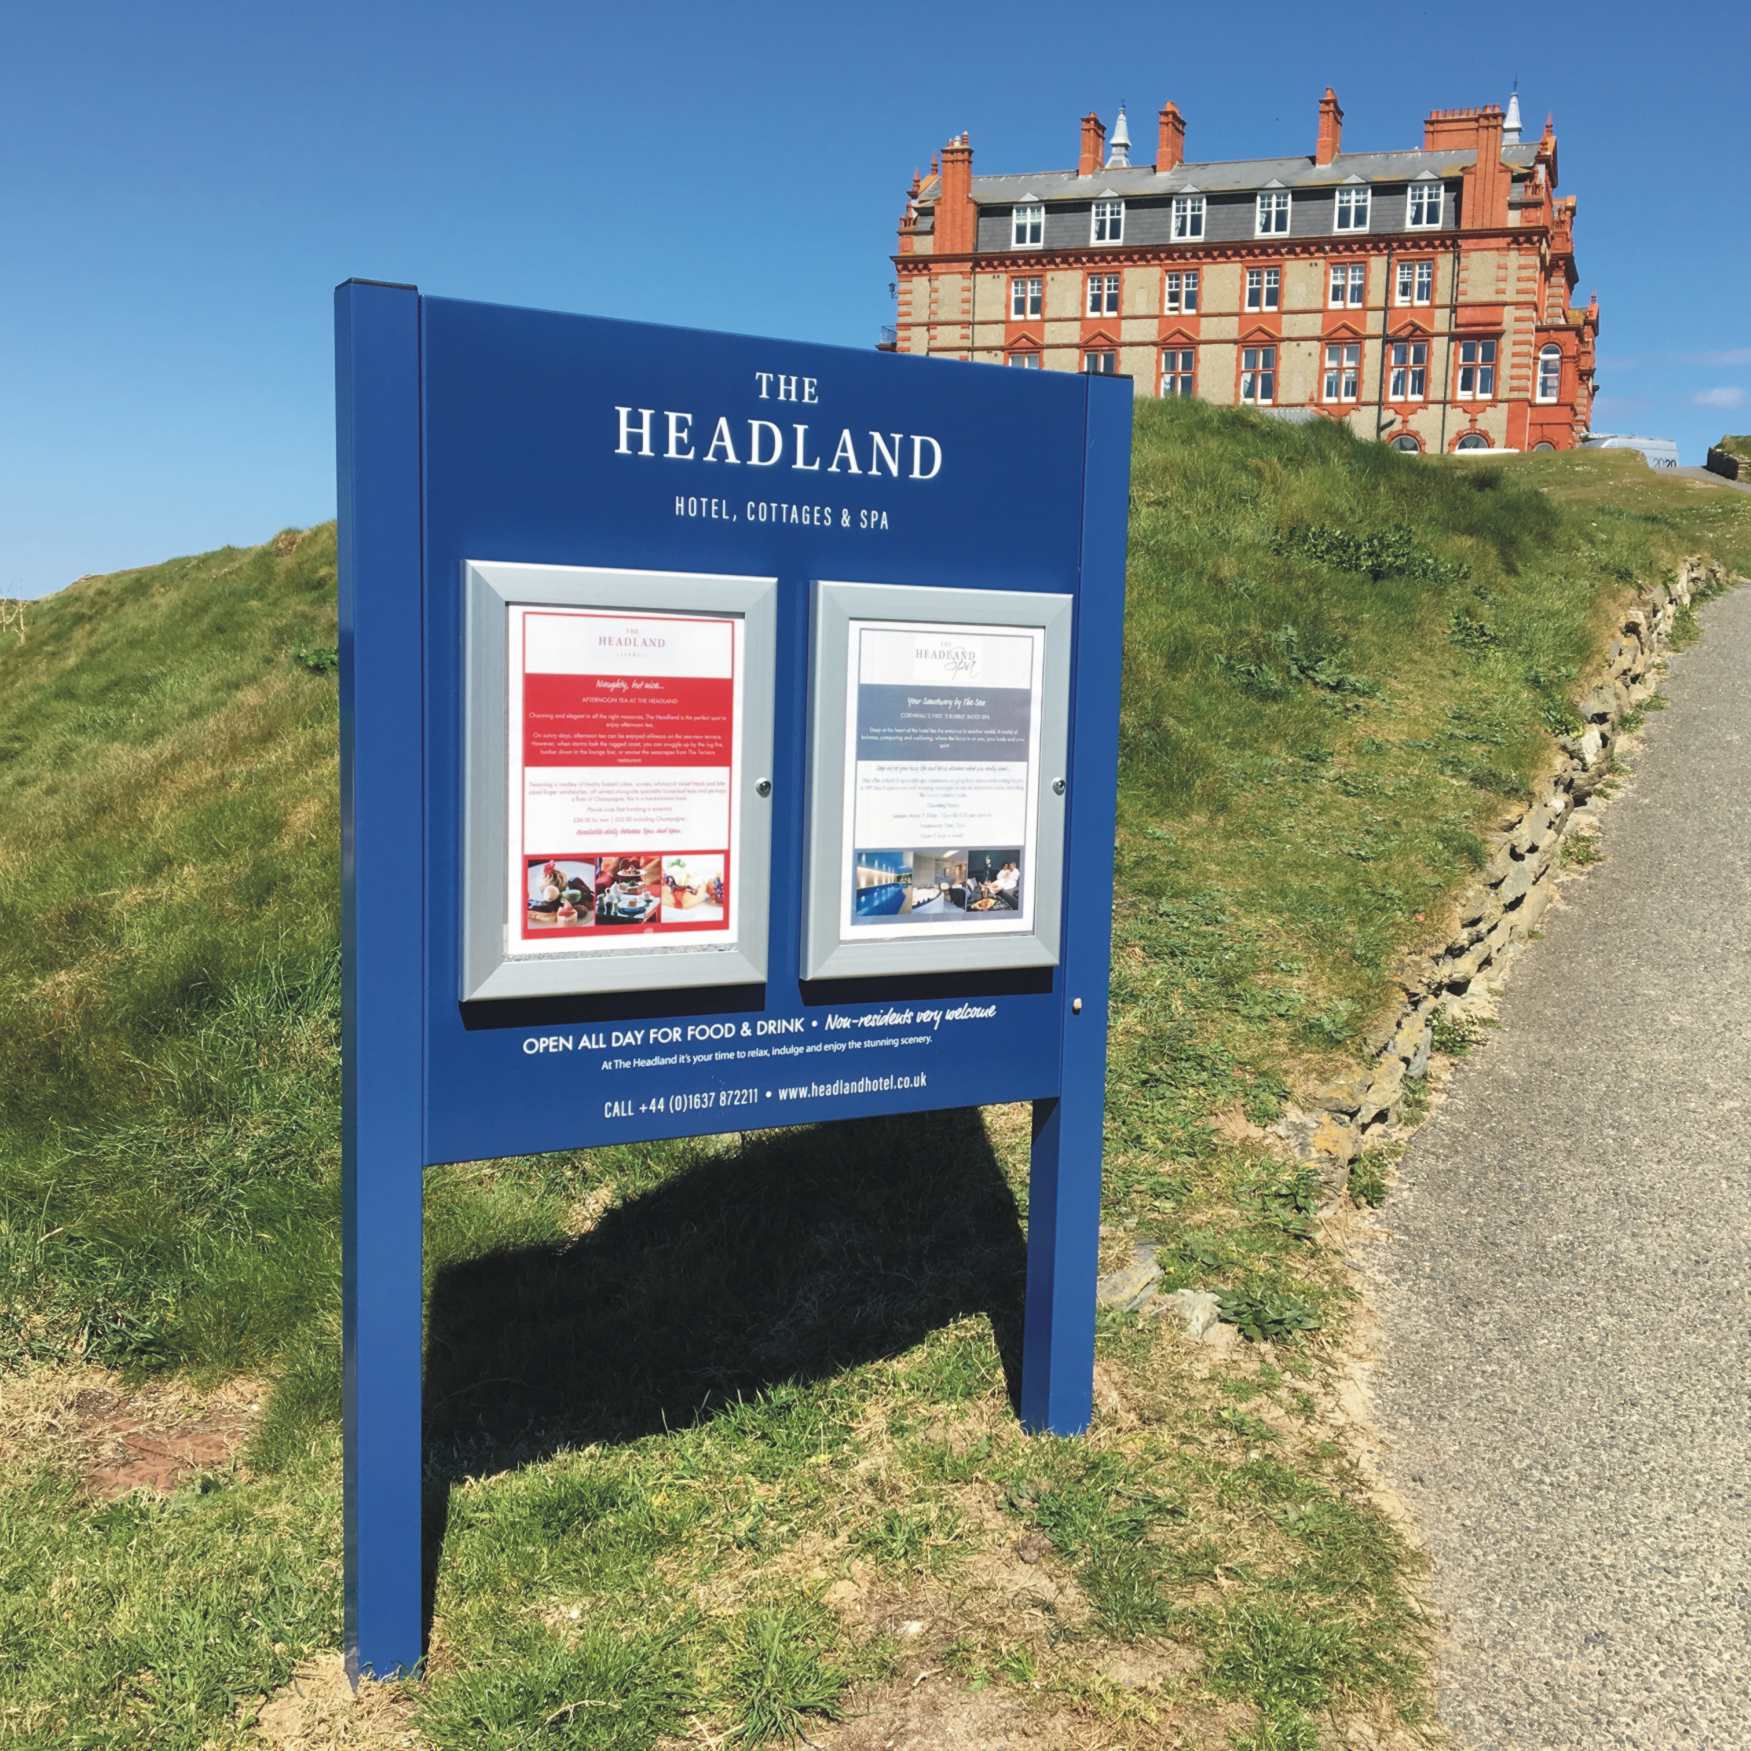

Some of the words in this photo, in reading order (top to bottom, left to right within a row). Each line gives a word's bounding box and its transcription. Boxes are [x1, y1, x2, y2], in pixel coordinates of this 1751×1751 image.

[755, 371, 819, 404] THE
[614, 406, 943, 480] HEADLAND
[675, 495, 737, 522] HOTEL,
[746, 500, 832, 527] COTTAGES
[840, 508, 851, 528] &
[859, 509, 889, 530] SPA
[598, 635, 666, 648] HEADLAND
[915, 648, 976, 661] HEADLAND
[522, 1035, 573, 1055] OPEN
[577, 1032, 607, 1050] ALL
[611, 1029, 645, 1048] DAY
[649, 1026, 682, 1044] FOR
[687, 1022, 736, 1041] FOOD
[739, 1021, 753, 1037] &
[756, 1017, 805, 1036] DRINK
[824, 1007, 914, 1031] Non-residents
[915, 1009, 943, 1031] very
[944, 1002, 997, 1021] welcome
[600, 1060, 613, 1071] At
[613, 1058, 632, 1070] The
[632, 1054, 678, 1068] Headland
[678, 1053, 692, 1064] it's
[692, 1053, 714, 1065] your
[714, 1050, 736, 1061] time
[736, 1050, 747, 1059] to
[747, 1047, 771, 1058] relax,
[771, 1044, 805, 1057] indulge
[805, 1042, 823, 1053] and
[823, 1041, 847, 1053] enjoy
[847, 1039, 863, 1050] the
[863, 1037, 900, 1049] stunning
[900, 1035, 933, 1045] scenery.
[604, 1100, 635, 1119] CALL
[639, 1097, 665, 1113] +44
[668, 1091, 716, 1114] (0)1637
[719, 1088, 758, 1107] 872211
[778, 1071, 927, 1101] www.headlandhotel.co.uk
